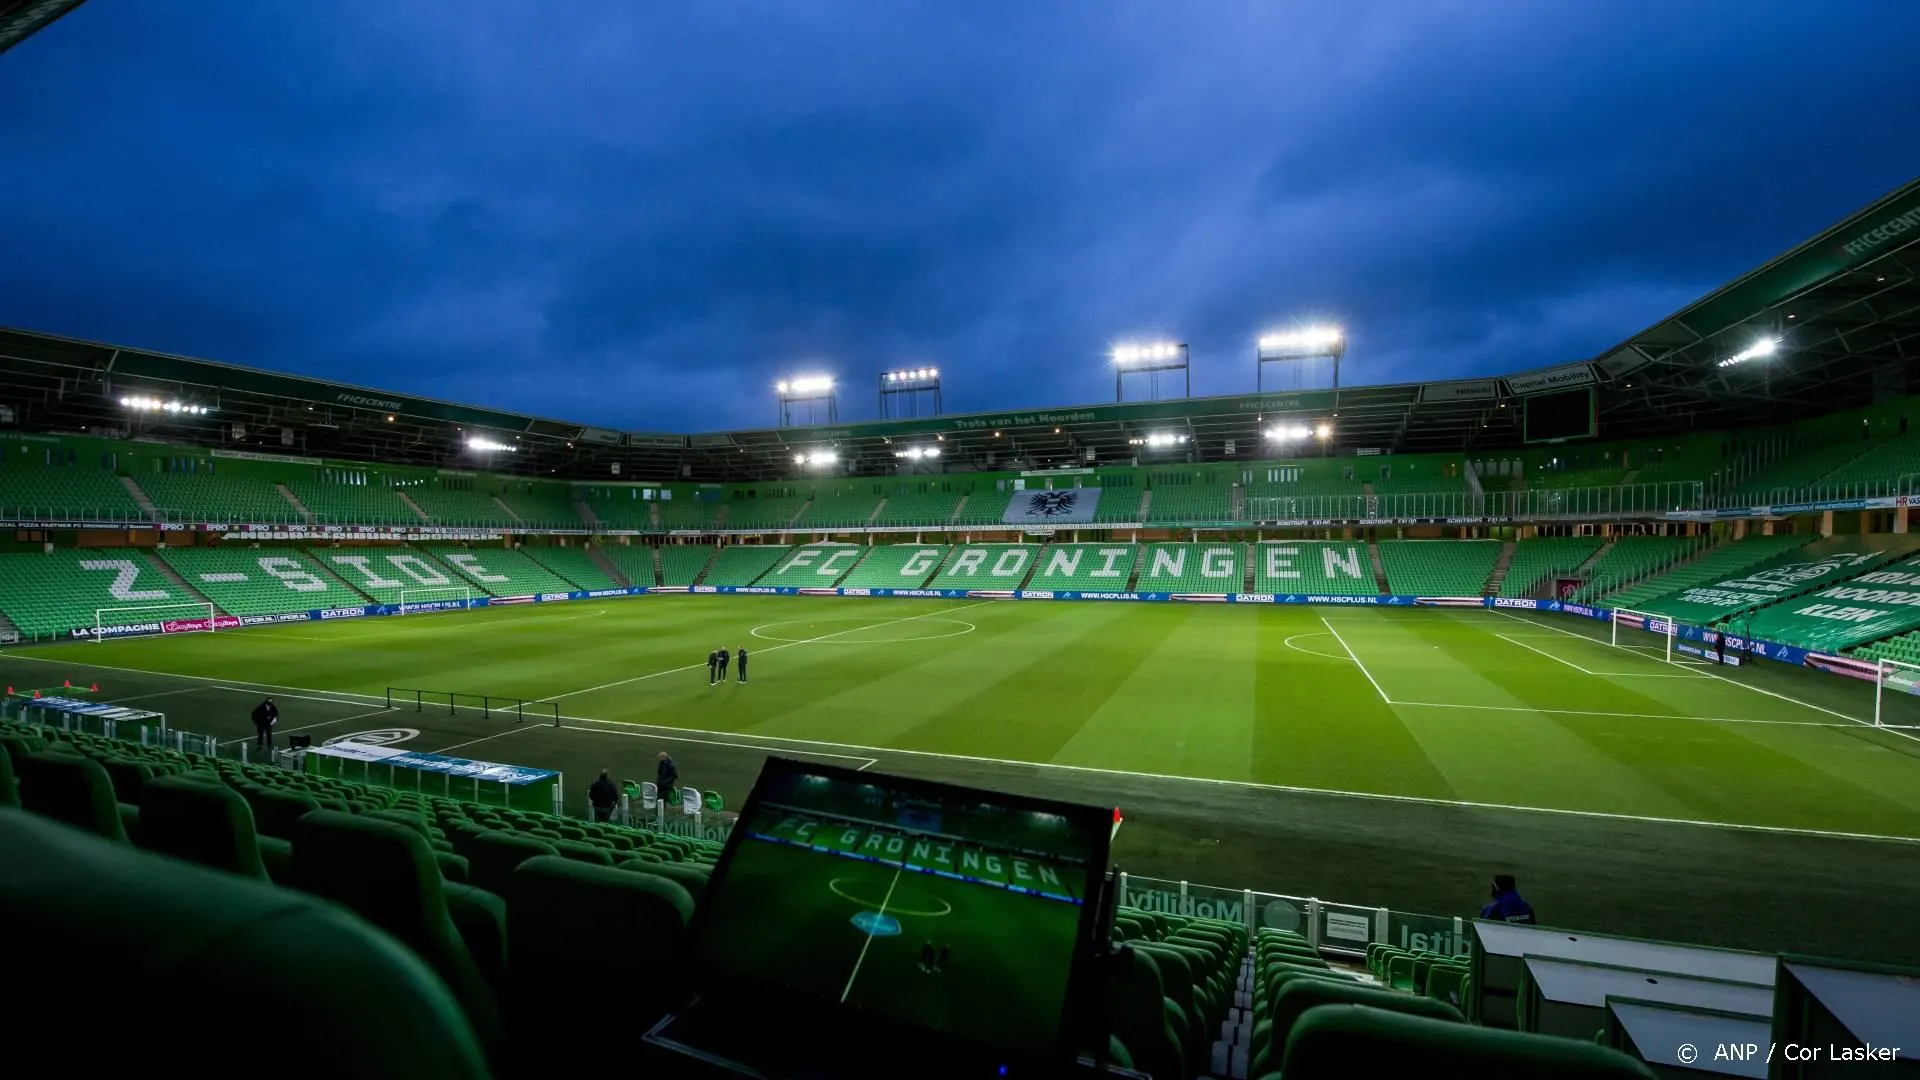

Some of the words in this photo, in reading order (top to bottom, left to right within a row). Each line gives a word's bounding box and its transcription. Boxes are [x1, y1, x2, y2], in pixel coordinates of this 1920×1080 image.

[1547, 371, 1590, 383] Mobility
[955, 420, 986, 429] Trots
[1015, 416, 1036, 425] het
[1039, 412, 1096, 422] Noorden
[777, 550, 859, 576] FC
[899, 547, 1362, 579] GRONINGEN
[1081, 592, 1139, 600] WWW.HSCPLUS.NL
[1235, 594, 1275, 603] DATRON
[1307, 595, 1378, 604] WWW.HSCPLUS.NL
[1495, 599, 1536, 609] DATRON
[321, 608, 365, 618] DATRON
[1792, 603, 1896, 623] KLEIN
[72, 628, 90, 637] LA
[90, 623, 160, 635] COMPAGNIE
[1649, 620, 1678, 636] DATRN
[777, 817, 818, 837] FC
[840, 829, 1061, 886] GRONINGEN
